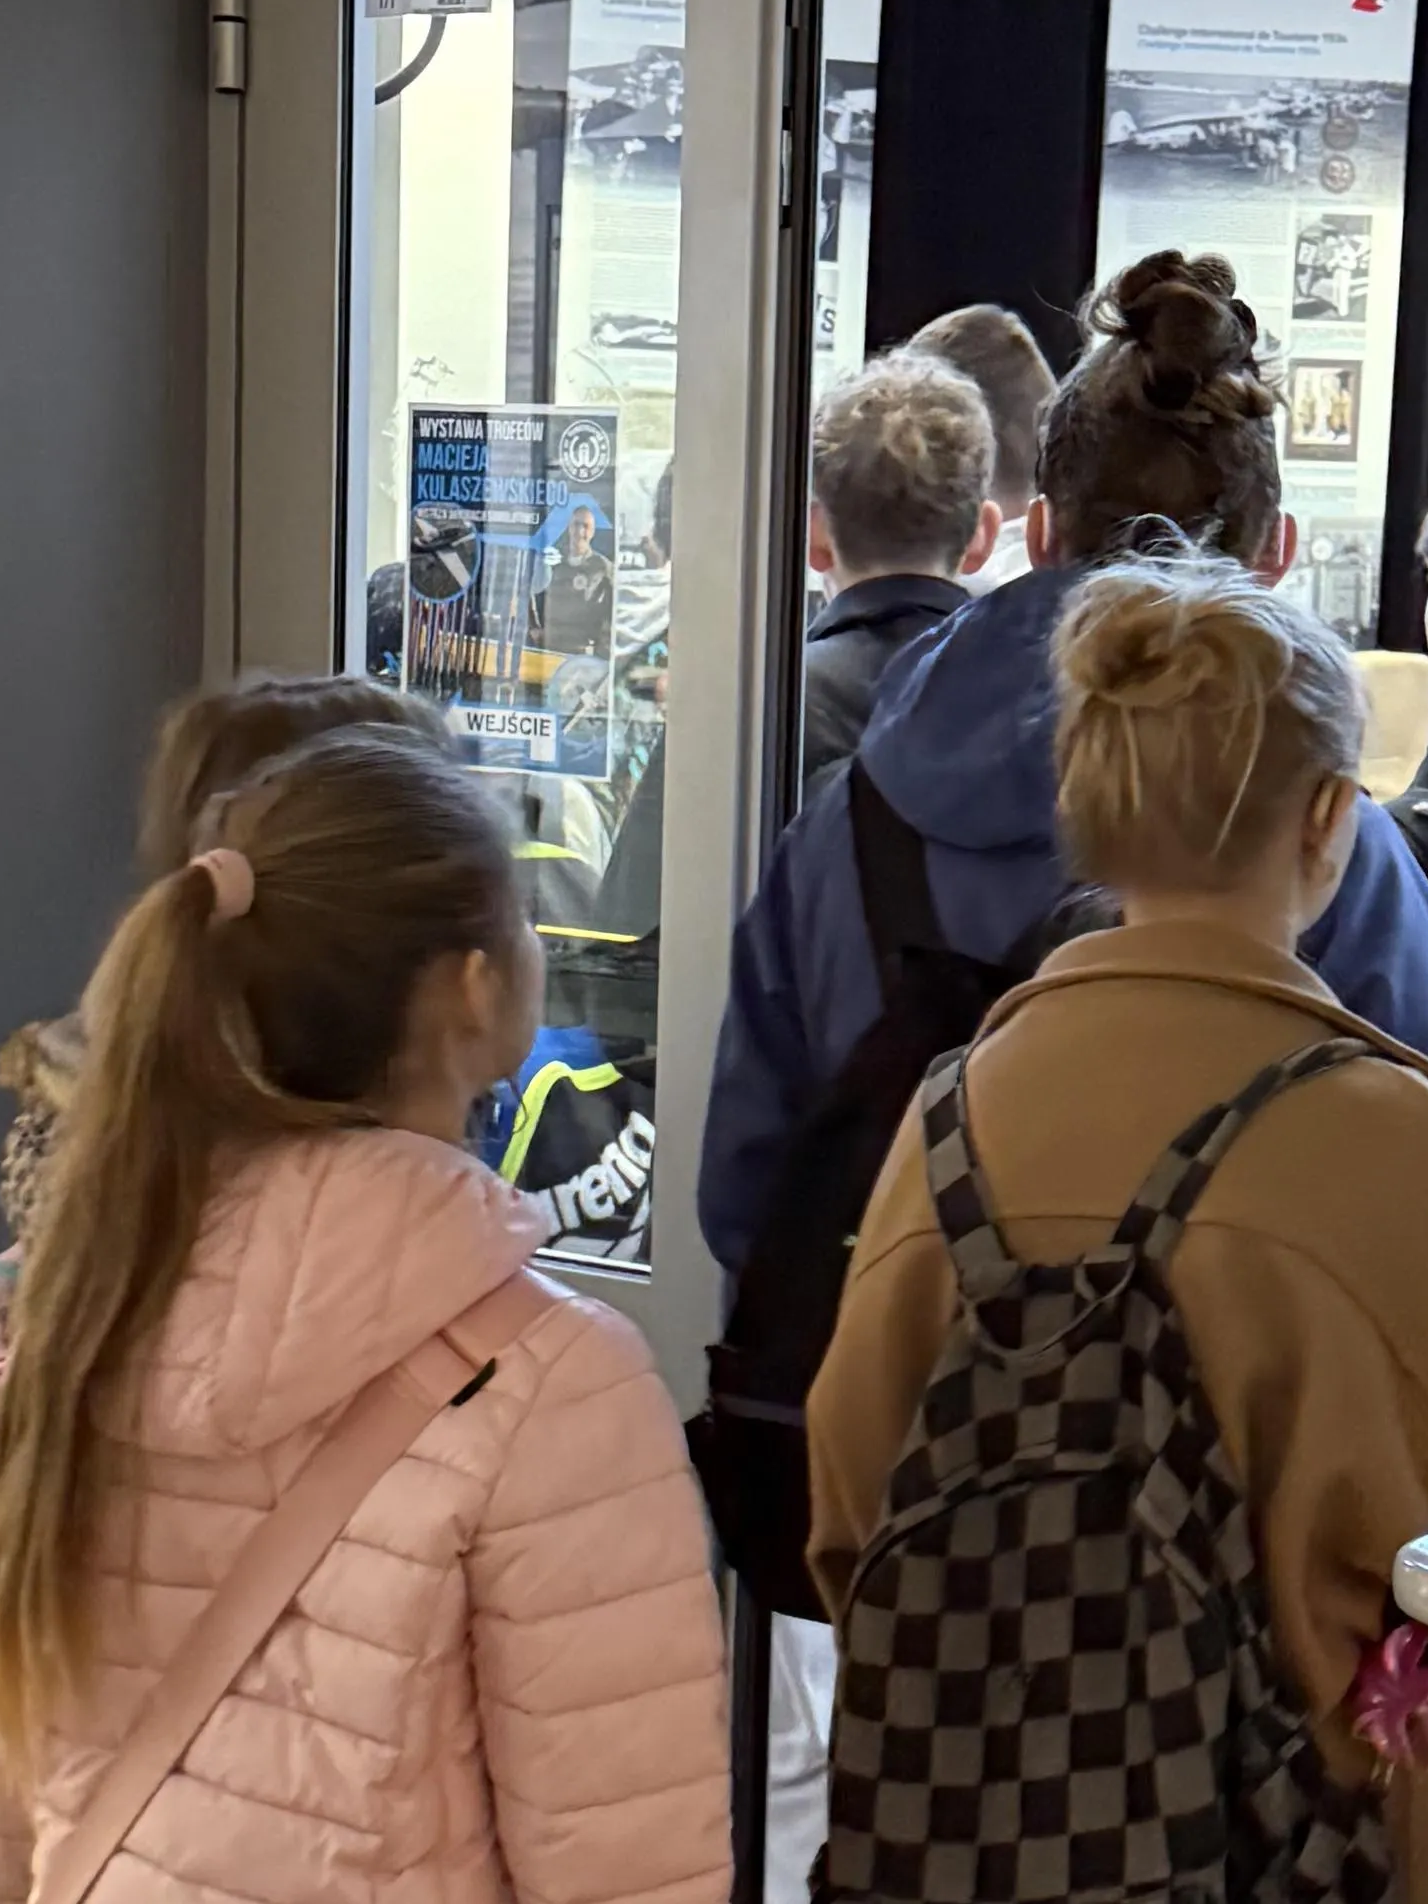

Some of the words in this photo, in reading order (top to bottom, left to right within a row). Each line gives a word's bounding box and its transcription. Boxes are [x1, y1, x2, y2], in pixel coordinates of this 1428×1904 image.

[419, 417, 484, 440] WYSTAWA
[487, 418, 544, 441] TROFEÓW
[417, 443, 490, 471] MACIEJA
[417, 473, 569, 507] KULASZEWSKIEGO
[466, 711, 553, 737] WEJŚCIE
[538, 1110, 656, 1234] rena
